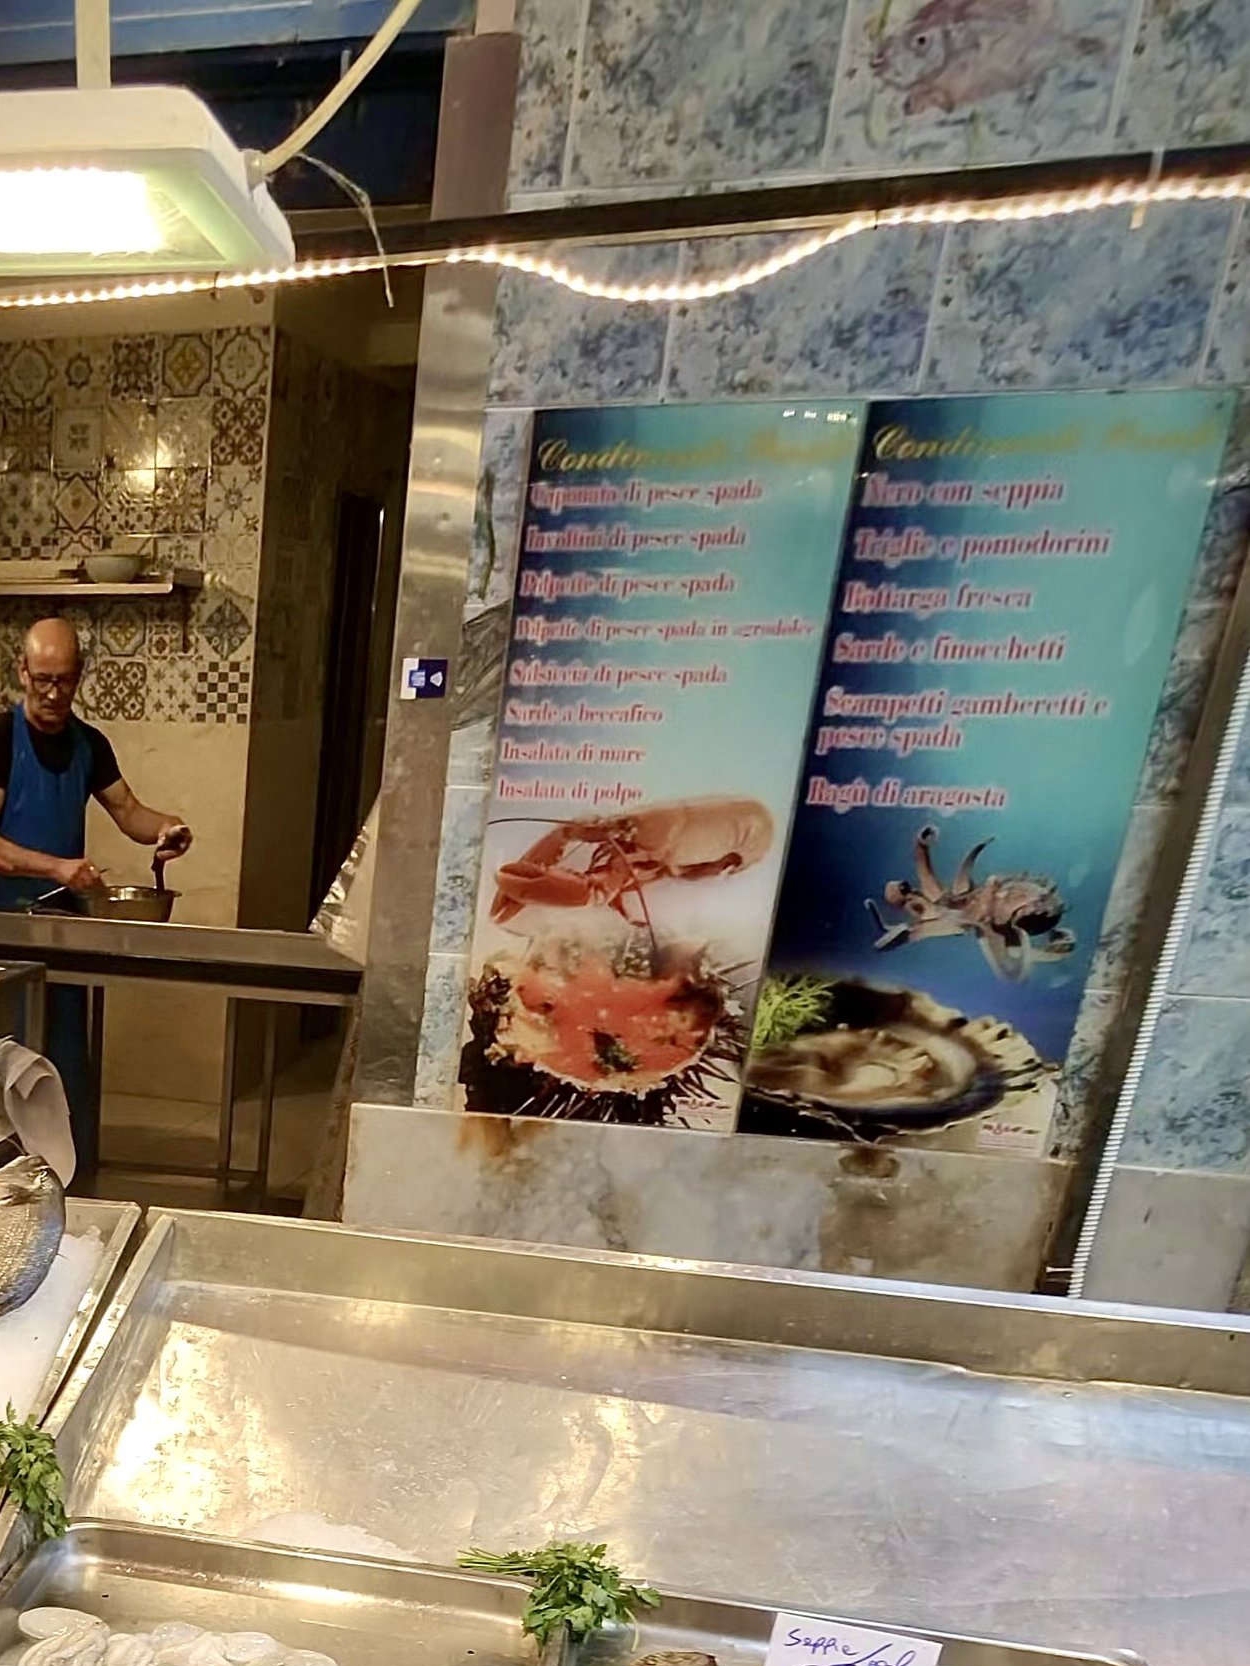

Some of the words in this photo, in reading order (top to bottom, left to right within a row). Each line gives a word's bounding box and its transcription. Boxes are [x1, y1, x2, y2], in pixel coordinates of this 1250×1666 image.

[622, 481, 641, 501] di
[645, 486, 701, 508] pesce
[705, 479, 763, 505] spada
[982, 475, 1064, 509] seppia
[608, 527, 628, 547] di
[631, 532, 685, 553] pesce
[690, 526, 746, 552] spada
[960, 529, 1112, 562] pomodorini
[600, 572, 618, 593] di
[621, 578, 671, 599] pesce
[681, 573, 736, 598] spada
[955, 585, 1033, 610] fresca
[584, 618, 603, 637] di
[711, 619, 728, 636] in
[593, 664, 611, 683] di
[615, 667, 668, 689] pesce
[673, 664, 728, 689] spada
[577, 703, 663, 724] beccafico
[950, 692, 1088, 717] gamberetti
[1093, 700, 1109, 714] e
[502, 742, 571, 762] Insalata
[576, 743, 594, 761] di
[599, 748, 646, 762] mare
[889, 724, 963, 755] spada
[498, 779, 566, 800] Insalata
[571, 781, 589, 800] di
[594, 784, 644, 806] polpo
[873, 780, 900, 806] di
[903, 786, 1008, 815] aragosta
